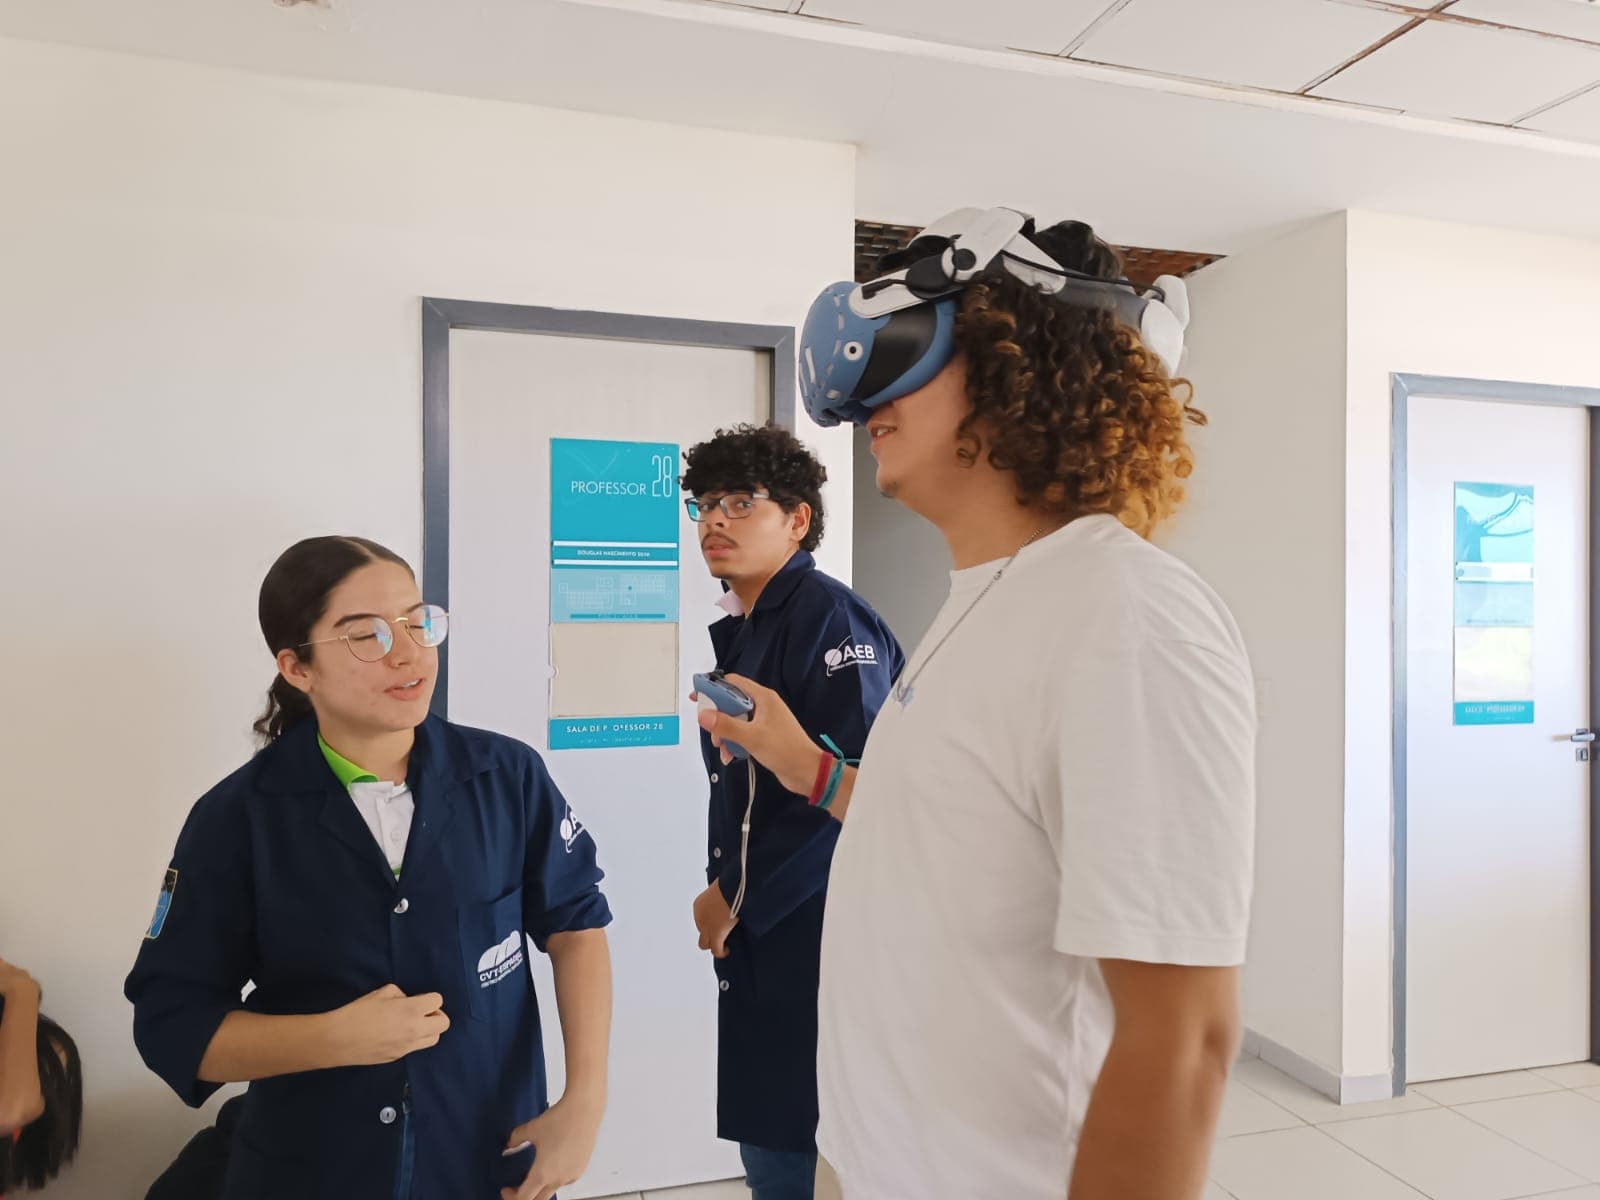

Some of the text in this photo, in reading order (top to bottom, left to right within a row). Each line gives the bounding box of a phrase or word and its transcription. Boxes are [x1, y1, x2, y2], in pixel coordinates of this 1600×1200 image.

[651, 454, 672, 498] 28
[571, 480, 647, 496] PROFESSOR
[843, 644, 875, 662] AEB
[566, 725, 587, 733] SALA
[602, 722, 651, 732] POESSOR
